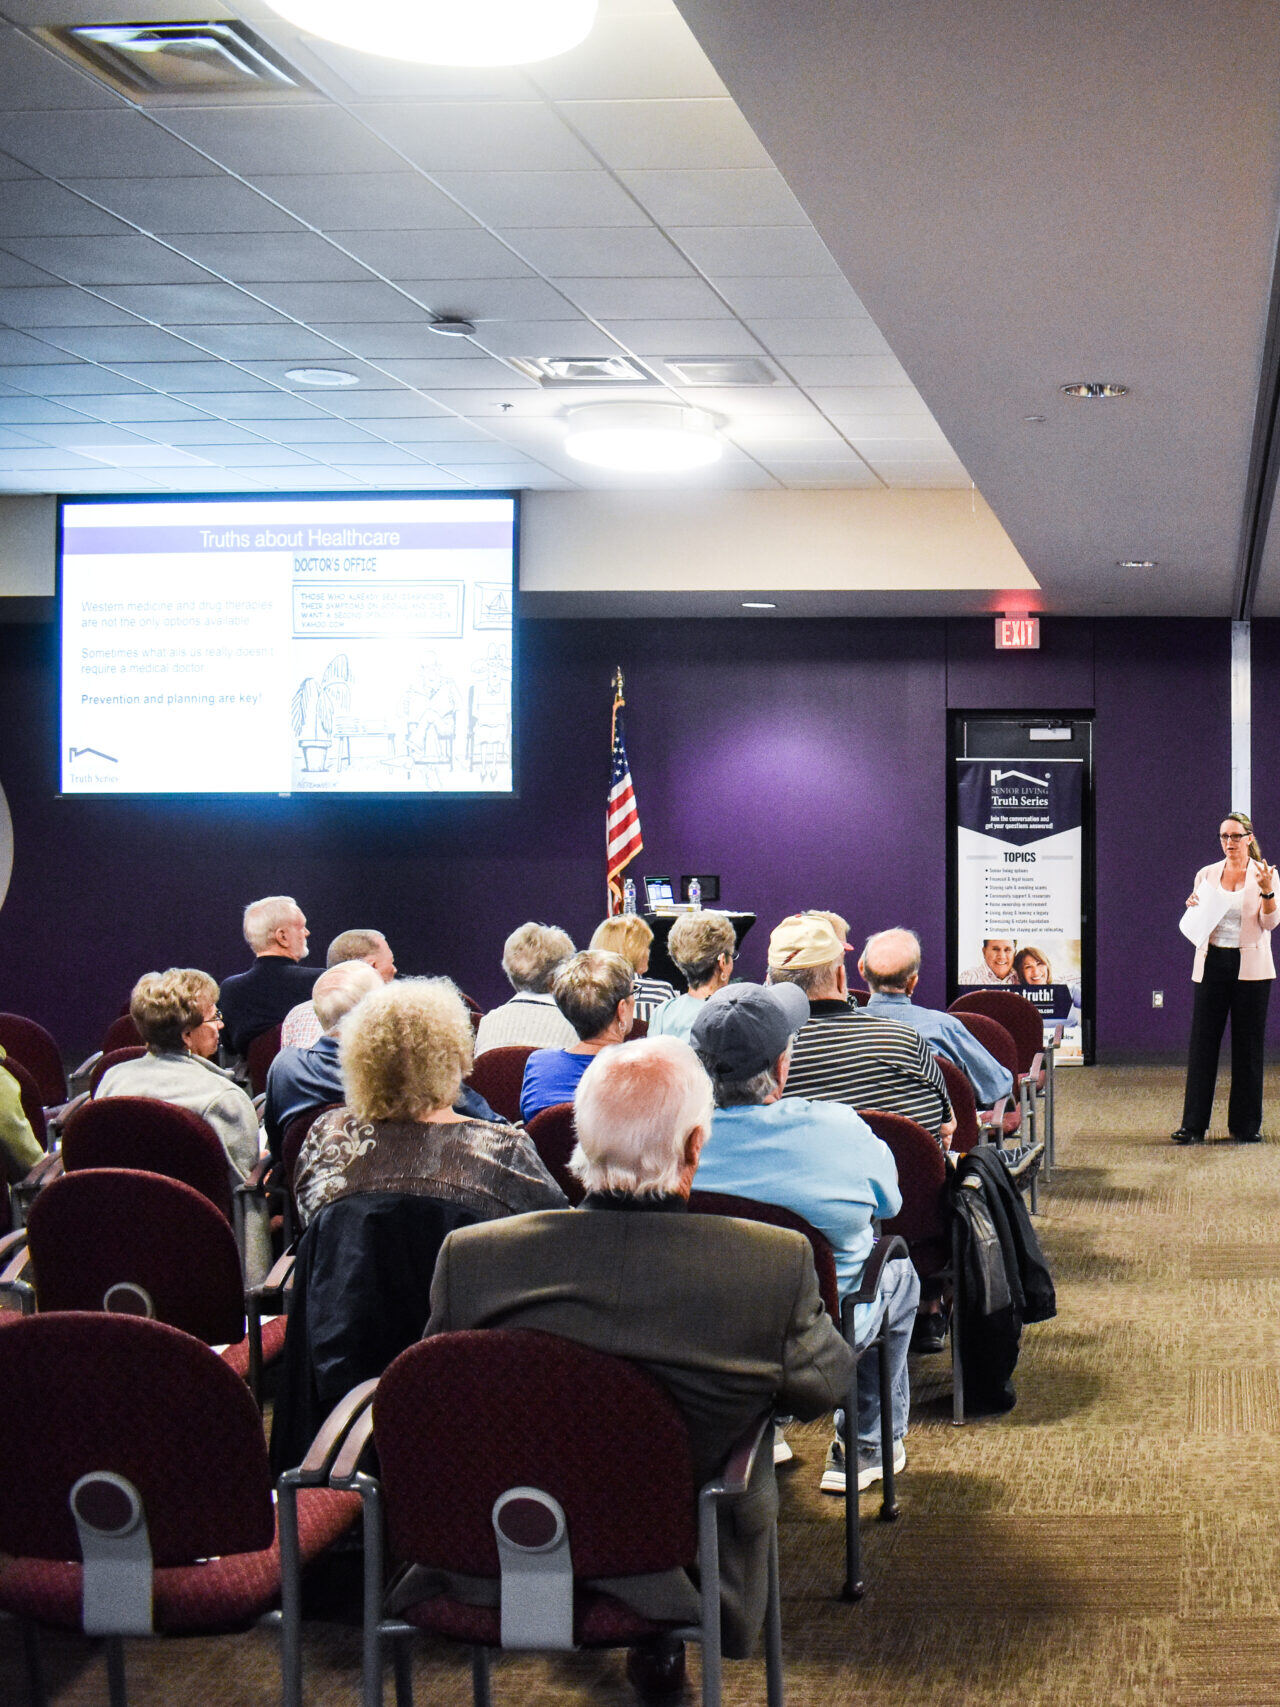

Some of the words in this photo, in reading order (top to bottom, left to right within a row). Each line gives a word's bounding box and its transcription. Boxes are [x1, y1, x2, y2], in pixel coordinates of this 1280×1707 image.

[200, 530, 250, 548] Truths
[256, 530, 303, 547] about
[308, 529, 400, 548] Healthcare
[294, 557, 340, 572] DOCTOR'S
[343, 557, 376, 572] OFFICE
[81, 601, 124, 612] Western
[128, 601, 174, 611] medicine
[177, 601, 195, 610] and
[81, 618, 97, 628] are
[102, 617, 117, 627] not
[120, 617, 136, 627] the
[139, 616, 160, 629] only
[1002, 621, 1034, 646] EXIT
[81, 648, 139, 659] Sometimes
[142, 648, 166, 657] what
[81, 663, 117, 675] require
[81, 694, 139, 704] Prevention
[144, 693, 164, 704] and
[167, 693, 215, 706] planning
[218, 694, 235, 703] are
[239, 692, 262, 705] key!
[70, 773, 93, 784] Truth
[992, 796, 1018, 805] Truth
[1021, 796, 1048, 805] Series
[1004, 852, 1036, 862] TOPICS
[1023, 989, 1054, 1001] truth!
